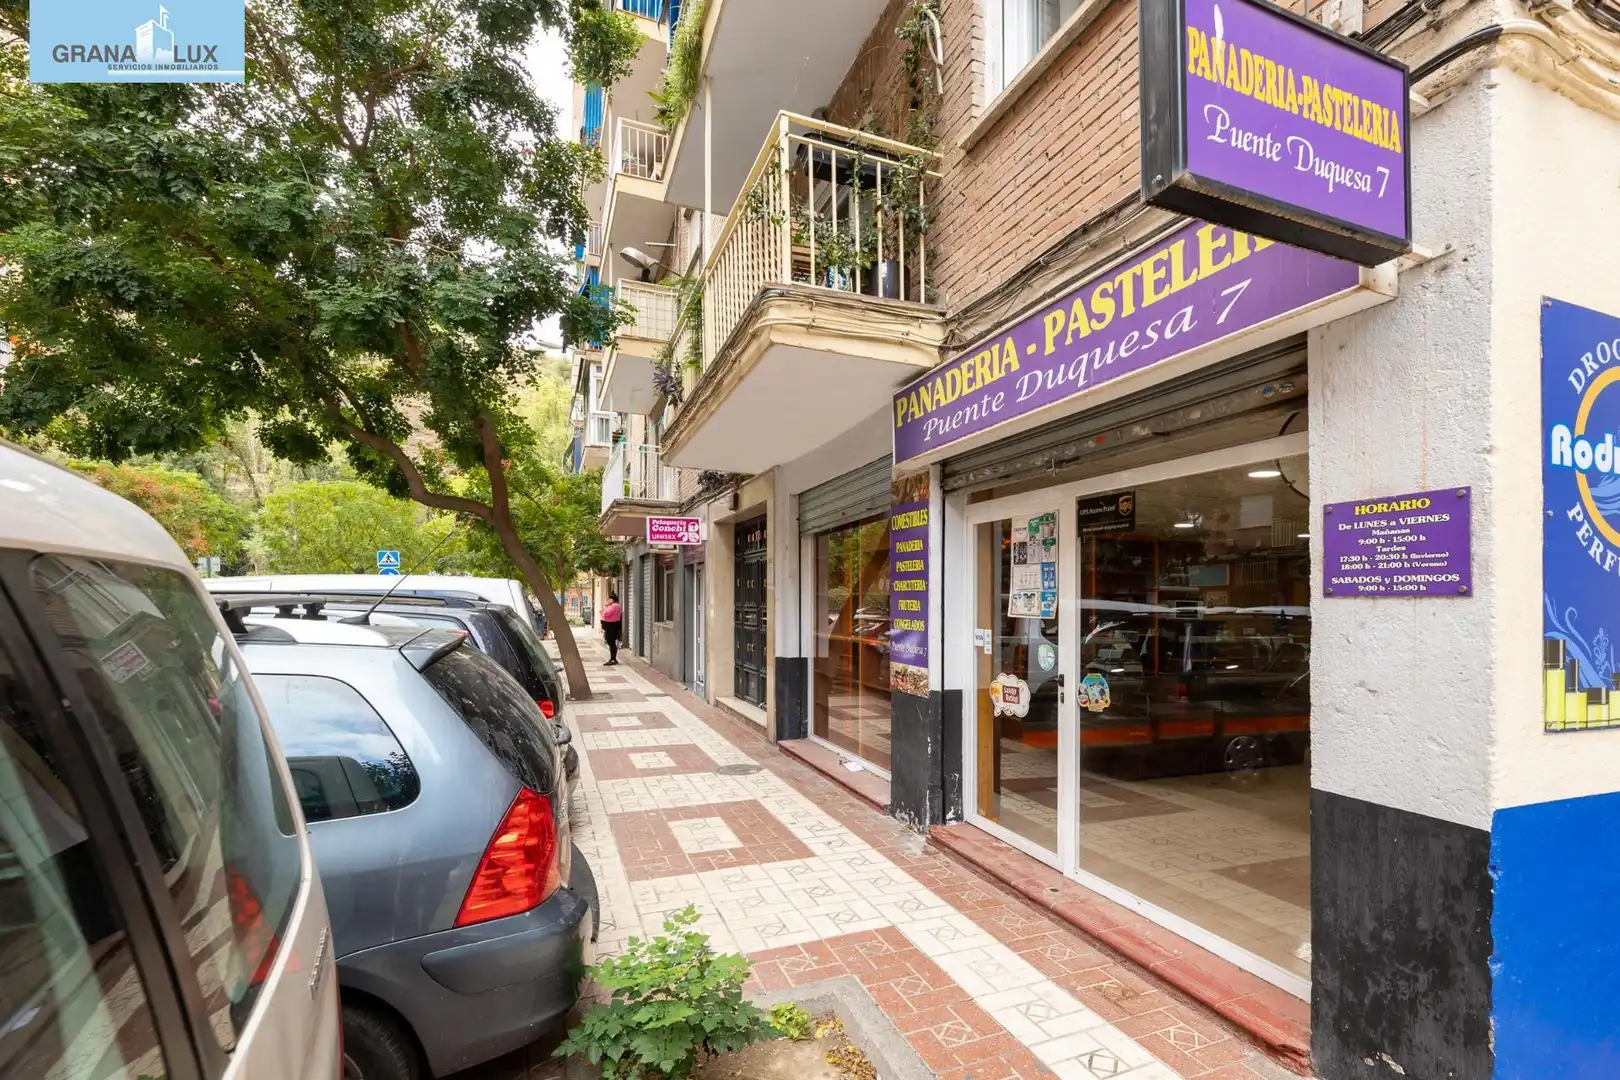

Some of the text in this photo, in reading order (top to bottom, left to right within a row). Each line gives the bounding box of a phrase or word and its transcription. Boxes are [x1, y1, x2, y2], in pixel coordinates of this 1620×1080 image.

[1203, 104, 1390, 199] Puente Duquesa 7
[896, 336, 1020, 428] PANADERIA
[1044, 224, 1275, 355] PASTELE
[923, 278, 1252, 442] Puente Duquesa 7
[1354, 498, 1431, 516] HORARIO
[892, 508, 928, 531] COMESTIBLES
[1338, 523, 1351, 531] De
[1354, 519, 1387, 530] LUNES
[1399, 513, 1450, 525] VIERNES
[1372, 527, 1410, 536] Mañanas
[1358, 538, 1378, 546] 9:00
[1393, 535, 1417, 543] 15:00
[1566, 501, 1620, 577] PERF
[896, 539, 923, 553] PANADERIA
[1376, 545, 1406, 553] Tardes
[1339, 555, 1360, 563] 17:30
[1374, 553, 1400, 561] 20:30
[1410, 551, 1449, 559] (Invierno)
[896, 560, 924, 572] PASTELERIA
[1341, 563, 1363, 571] 18:00
[1365, 562, 1371, 570] h
[1378, 561, 1402, 569] 21:00
[1412, 560, 1447, 568] (Verano)
[1332, 575, 1382, 584] SABADOS
[1393, 574, 1460, 583] DOMINGOS
[1392, 584, 1417, 592] 15:00
[898, 599, 921, 612] FRUTERIA
[893, 618, 925, 632] CONGELADOS
[923, 647, 928, 657] 7
